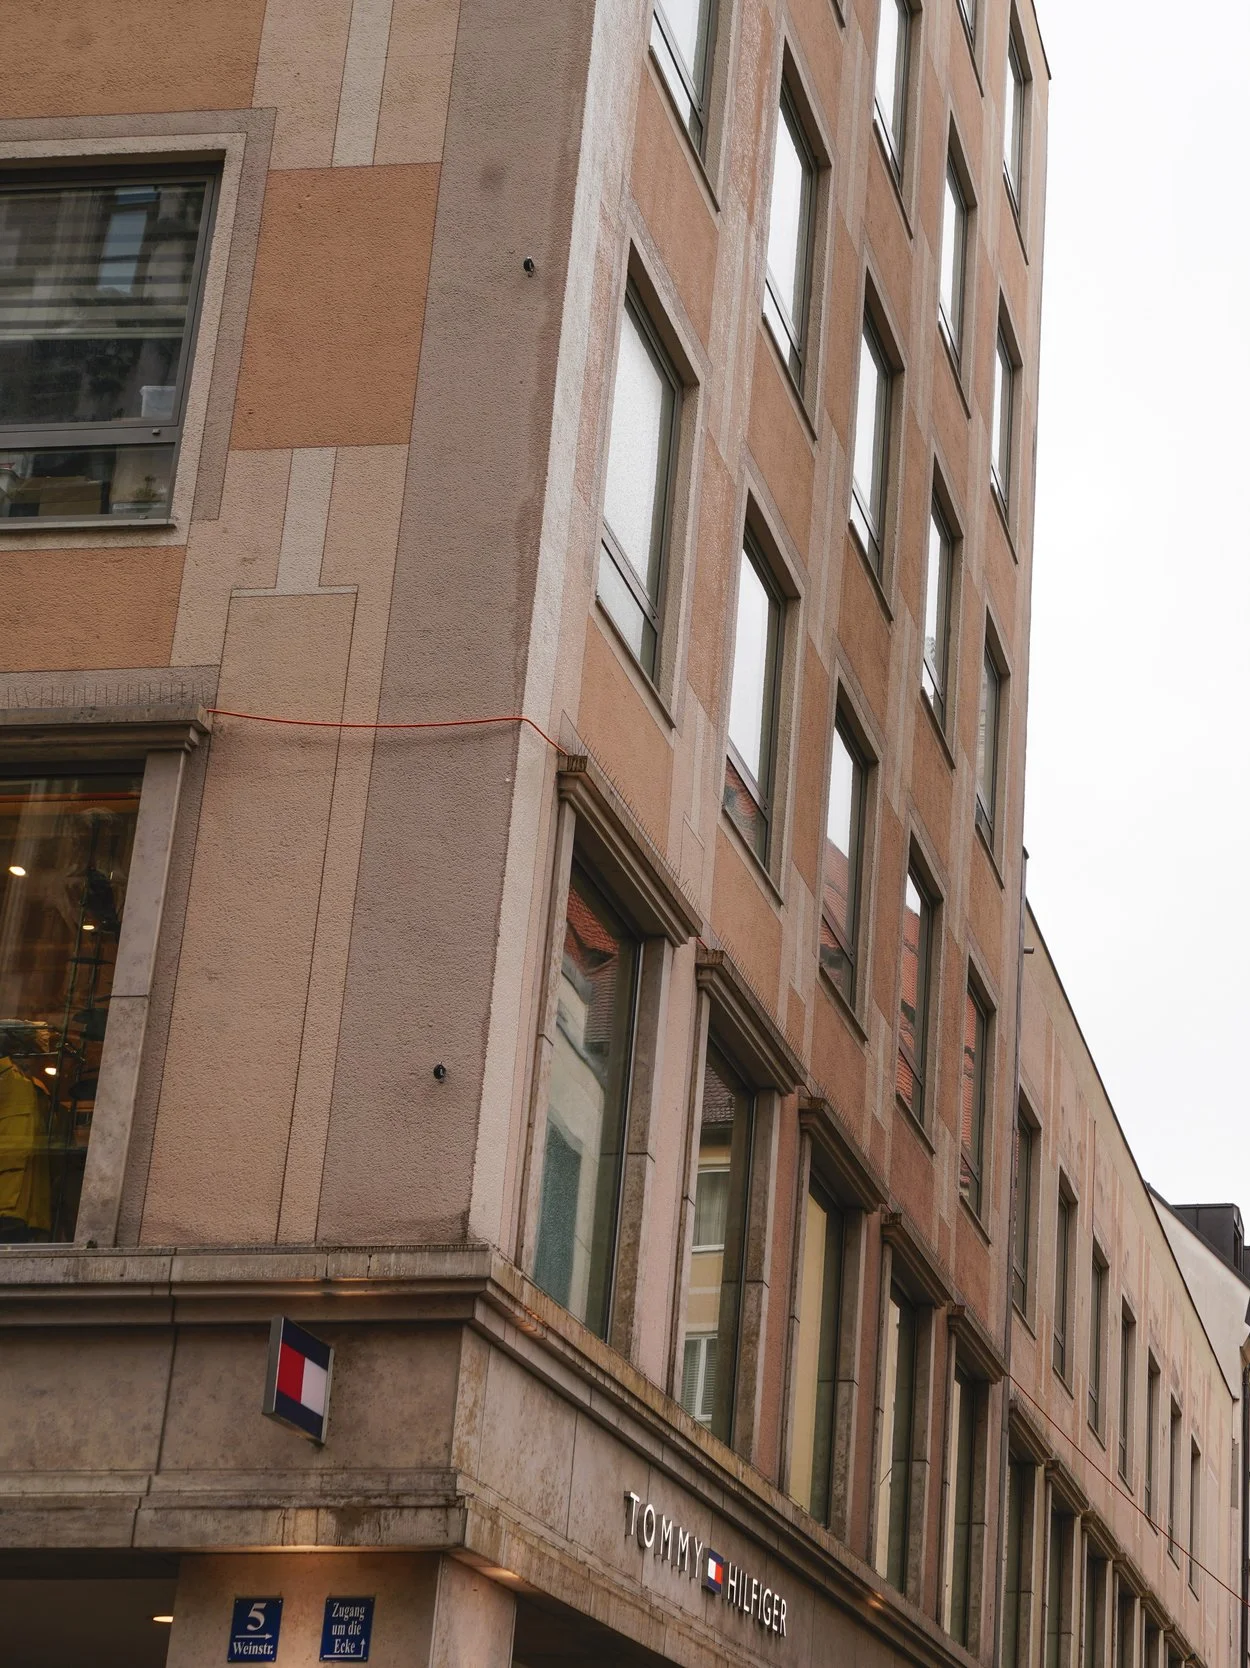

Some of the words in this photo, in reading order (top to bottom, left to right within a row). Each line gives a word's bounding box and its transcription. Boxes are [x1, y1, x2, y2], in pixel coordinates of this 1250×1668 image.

[626, 1491, 703, 1579] TOMMY
[726, 1561, 787, 1637] HILFIGER
[246, 1602, 267, 1631] 5
[332, 1602, 365, 1621] Zugang
[332, 1624, 346, 1636] um
[348, 1621, 362, 1636] die
[232, 1641, 274, 1656] Weinstr.
[334, 1638, 356, 1655] Ecke
